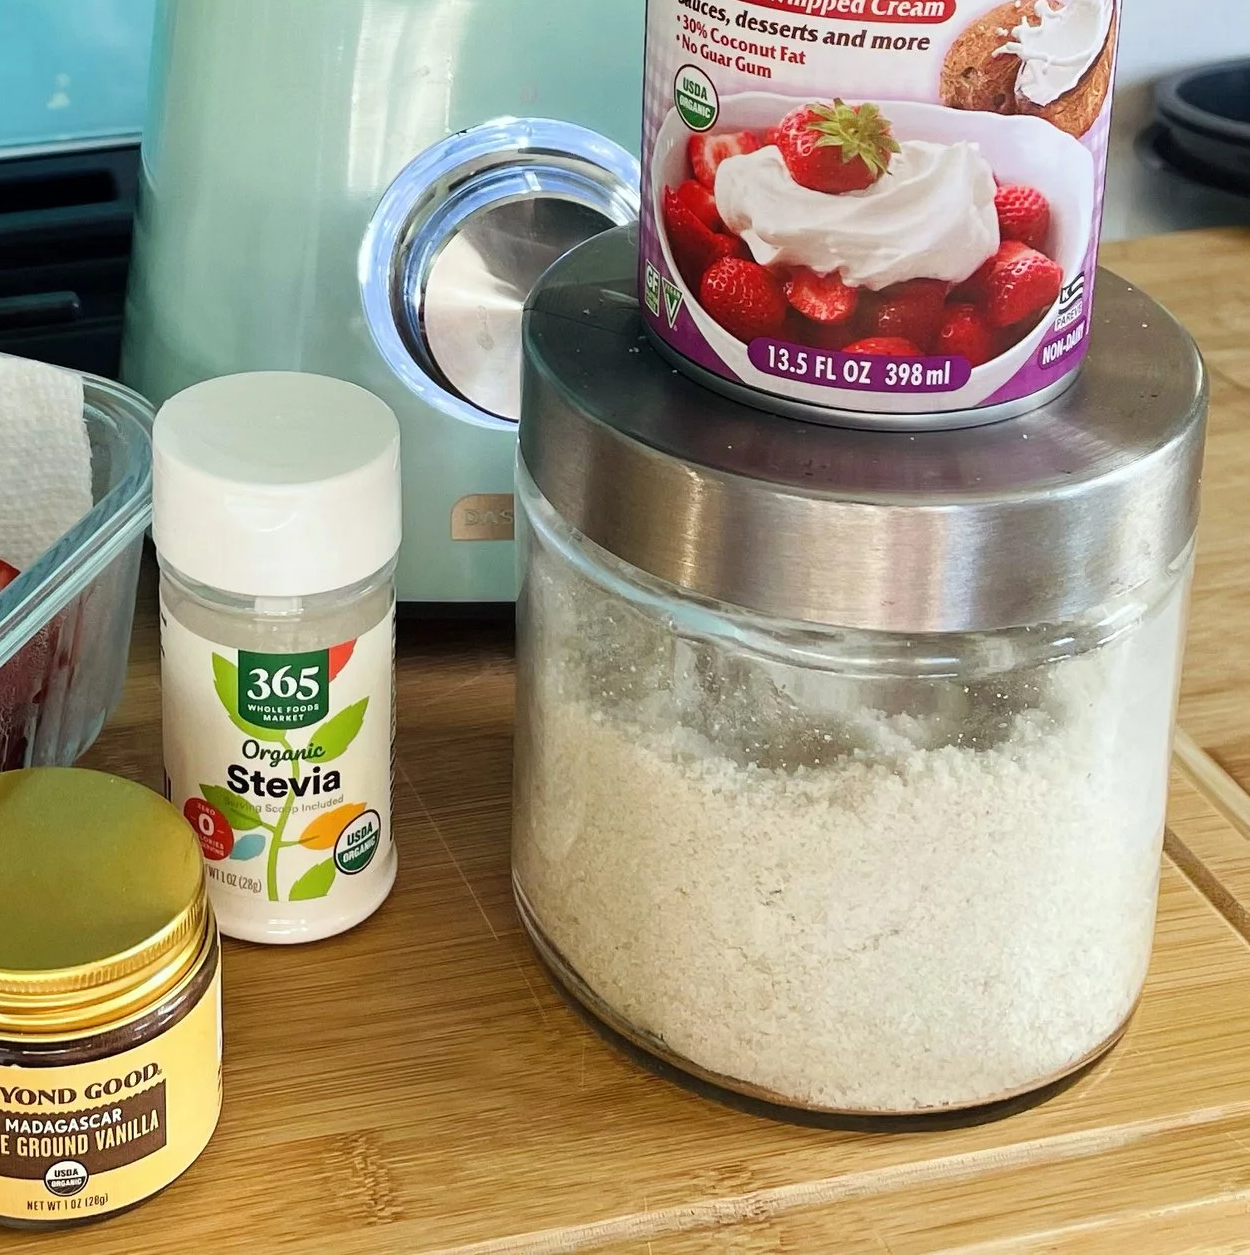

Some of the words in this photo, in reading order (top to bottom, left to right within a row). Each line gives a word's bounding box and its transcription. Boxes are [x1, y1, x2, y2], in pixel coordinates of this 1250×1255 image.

[682, 17, 707, 39] 30%
[711, 31, 776, 60] Coconut
[781, 47, 806, 65] Fat
[735, 10, 818, 43] desserts
[823, 30, 867, 49] and
[871, 35, 930, 51] more
[682, 34, 698, 53] No
[700, 45, 733, 67] Guar
[735, 58, 772, 79] Gum
[683, 77, 707, 100] USDA
[679, 94, 711, 119] ORGANIC
[646, 265, 659, 293] GF
[767, 345, 808, 375] 13.5
[815, 356, 837, 380] FL
[843, 360, 871, 384] OZ
[885, 360, 923, 384] 398
[926, 360, 951, 385] ml
[247, 665, 320, 700] 365
[247, 704, 283, 714] WHOLE
[286, 703, 319, 714] FOODS
[263, 714, 304, 722] MARKET
[242, 739, 326, 767] Organic
[227, 764, 341, 798] Stevia
[265, 803, 299, 814] Scop
[302, 793, 344, 812] Included
[198, 813, 214, 836] 0
[347, 821, 372, 846] USDA
[343, 835, 376, 863] ORGANIC
[209, 865, 220, 880] WT
[227, 872, 237, 886] OZ
[239, 875, 262, 893] (28g)
[85, 1062, 159, 1100] GOOD
[5, 1108, 122, 1134] MADAGASCAR
[17, 1134, 88, 1158] GROUND
[95, 1109, 159, 1151] VANILLA
[51, 1178, 83, 1187] ORGANIC
[54, 1168, 79, 1178] USDA
[27, 1200, 44, 1211] NET
[47, 1200, 61, 1211] WT
[70, 1198, 82, 1209] OZ
[85, 1193, 108, 1207] (28g)
